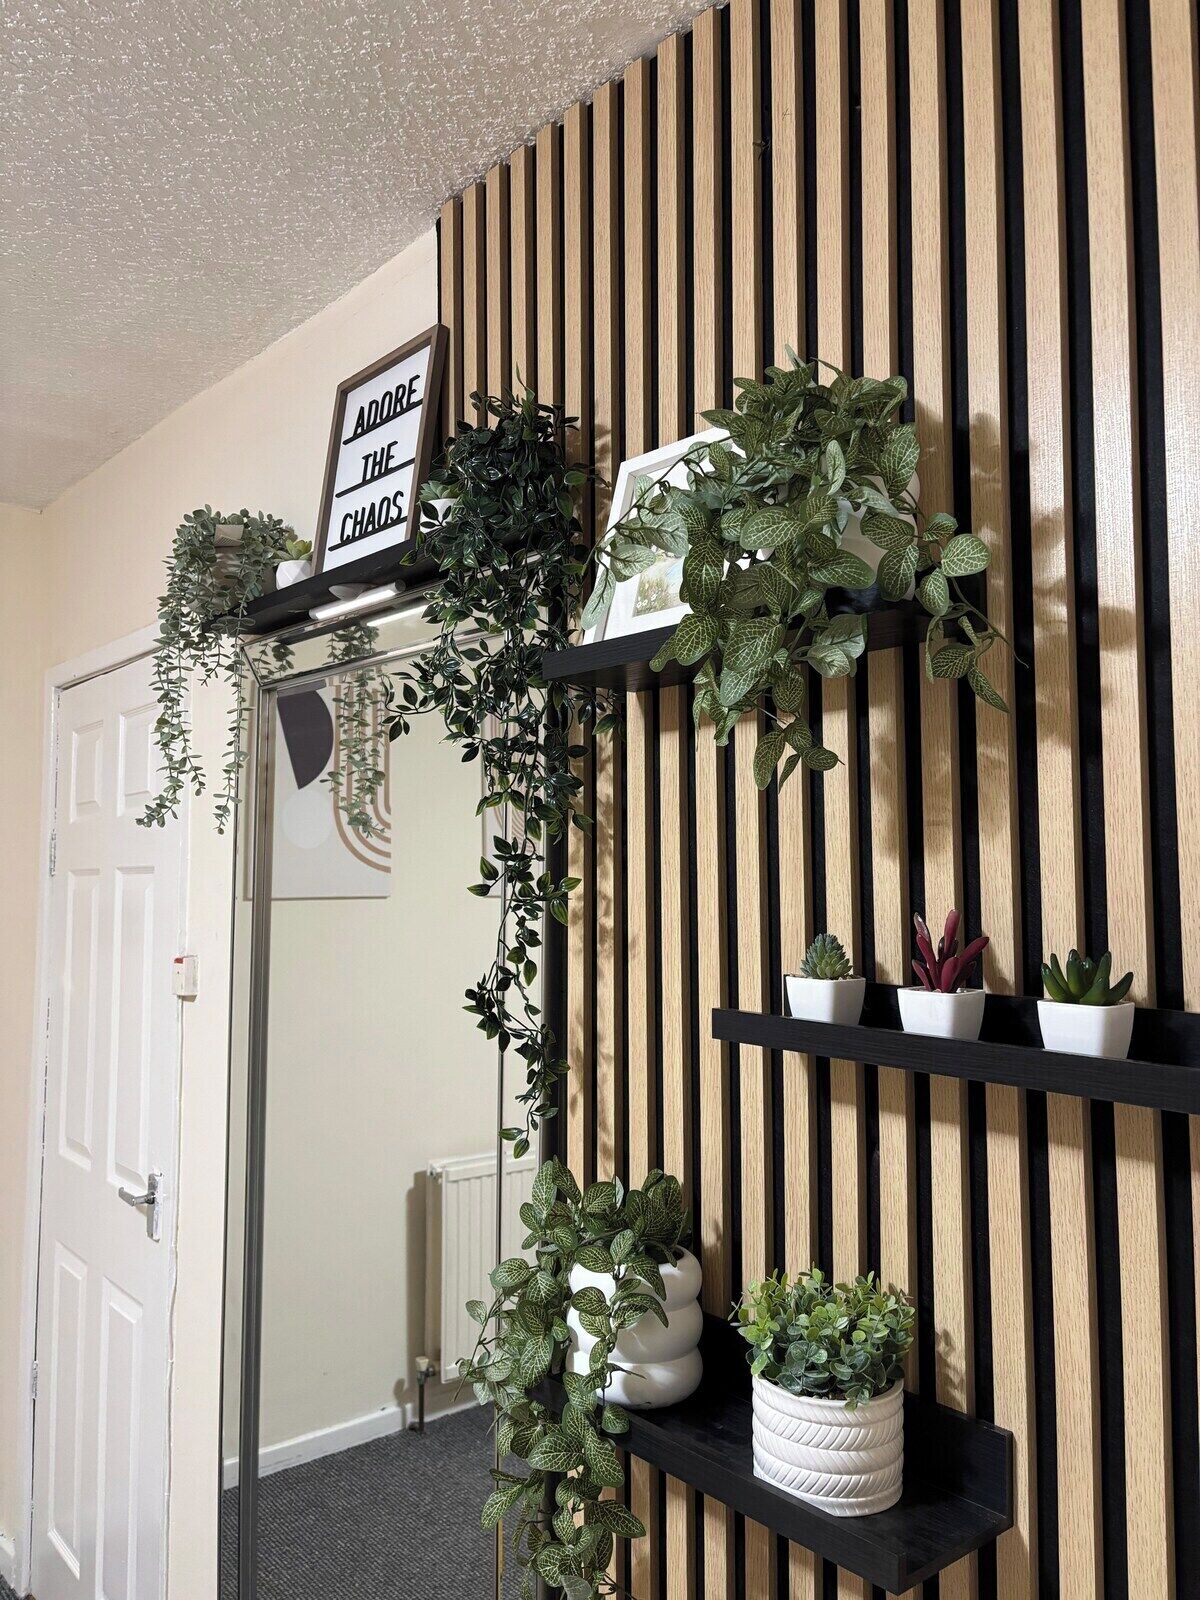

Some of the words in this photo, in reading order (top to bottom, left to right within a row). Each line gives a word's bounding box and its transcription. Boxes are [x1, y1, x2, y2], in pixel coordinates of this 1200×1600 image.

[353, 374, 420, 437] ADORE
[361, 440, 398, 483] THE
[339, 490, 404, 543] CHAOS
